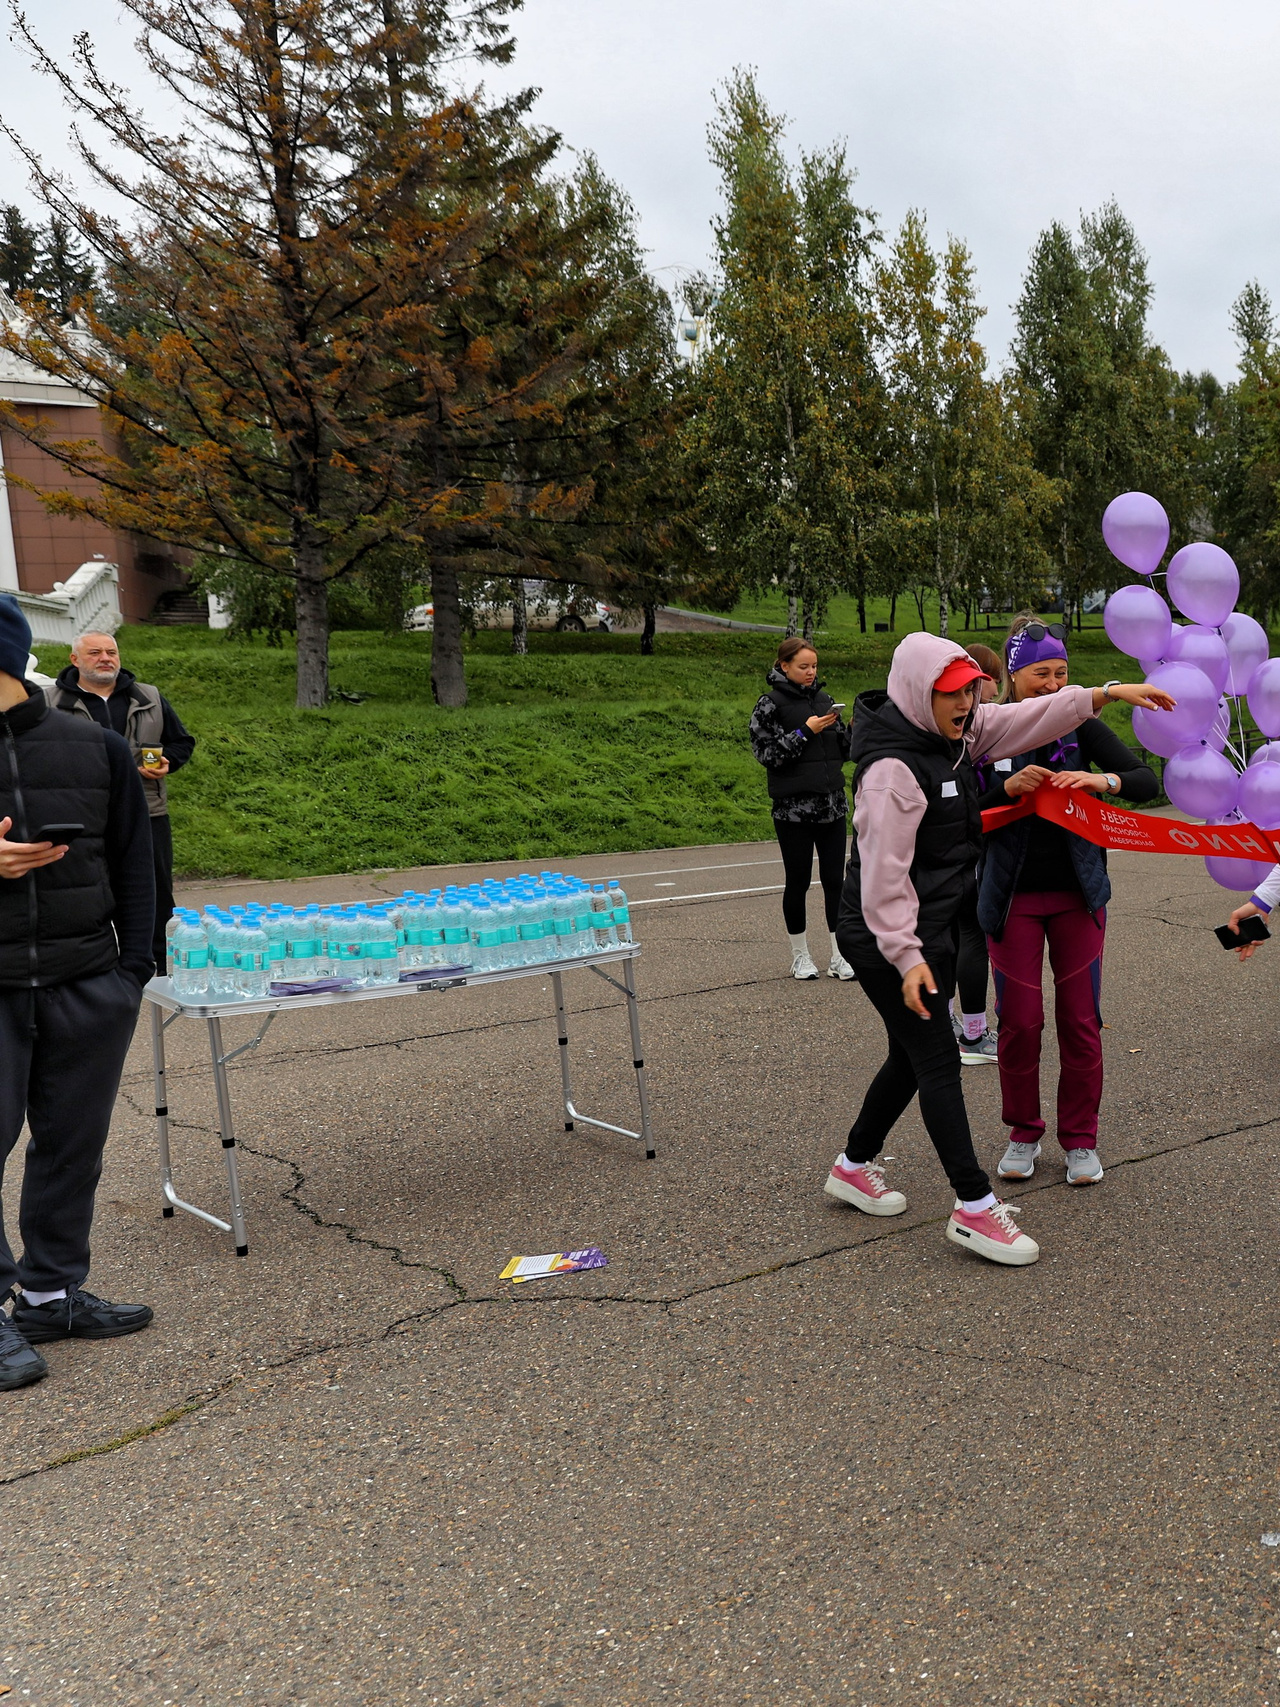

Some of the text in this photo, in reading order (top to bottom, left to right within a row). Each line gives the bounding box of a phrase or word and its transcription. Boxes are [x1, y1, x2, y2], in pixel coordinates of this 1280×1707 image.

[1065, 798, 1074, 815] 5
[1100, 809, 1139, 828] 5 ВЁРСТ
[1101, 823, 1151, 840] КРАСНОЯРСК
[1109, 835, 1156, 847] НАБЕРЕЖНАЯ
